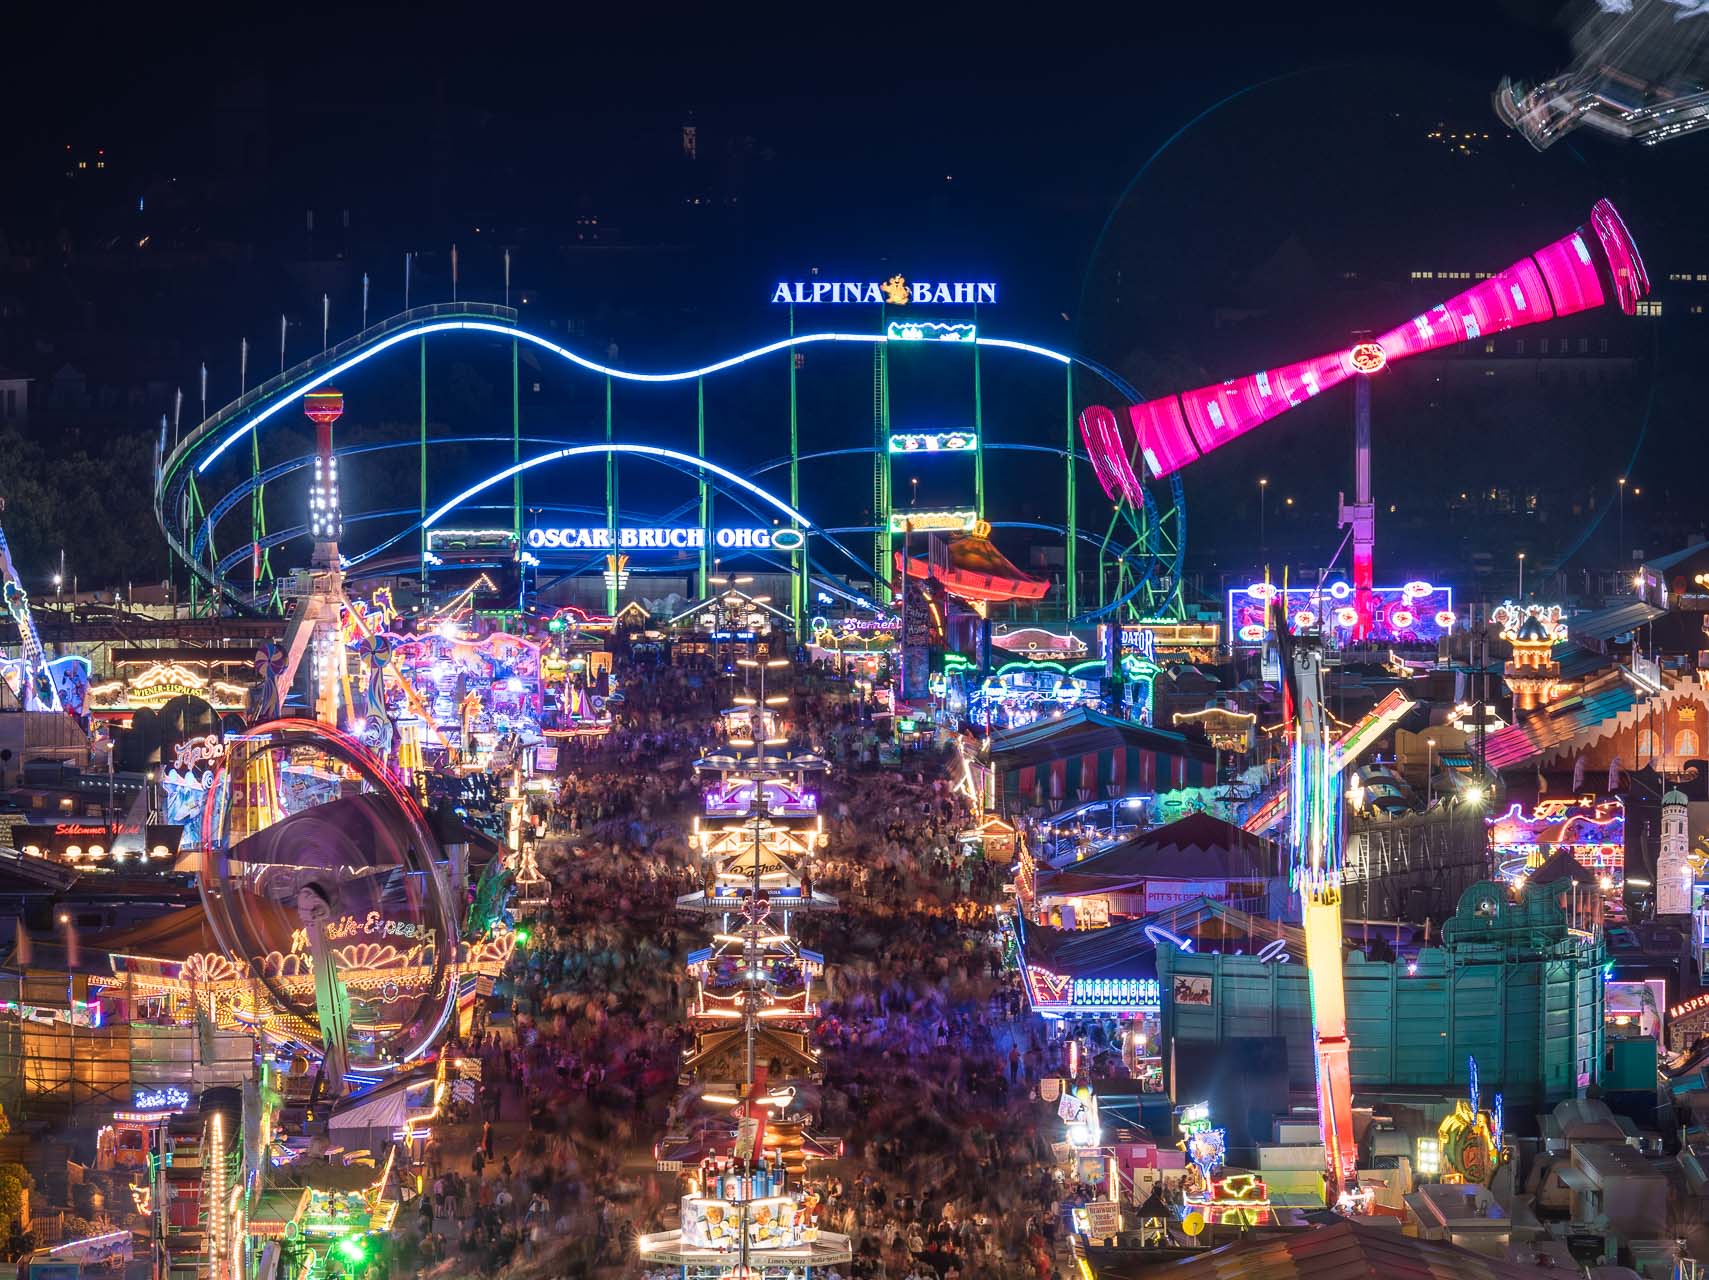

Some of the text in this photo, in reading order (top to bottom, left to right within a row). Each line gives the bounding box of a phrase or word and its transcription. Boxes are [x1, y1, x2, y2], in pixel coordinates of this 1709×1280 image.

[772, 282, 997, 303] ALPINA BAHN
[528, 528, 770, 548] OSCAR BRUCH OHG
[134, 684, 203, 697] WIENER-EISPALAST
[55, 823, 106, 835] Schlemmer
